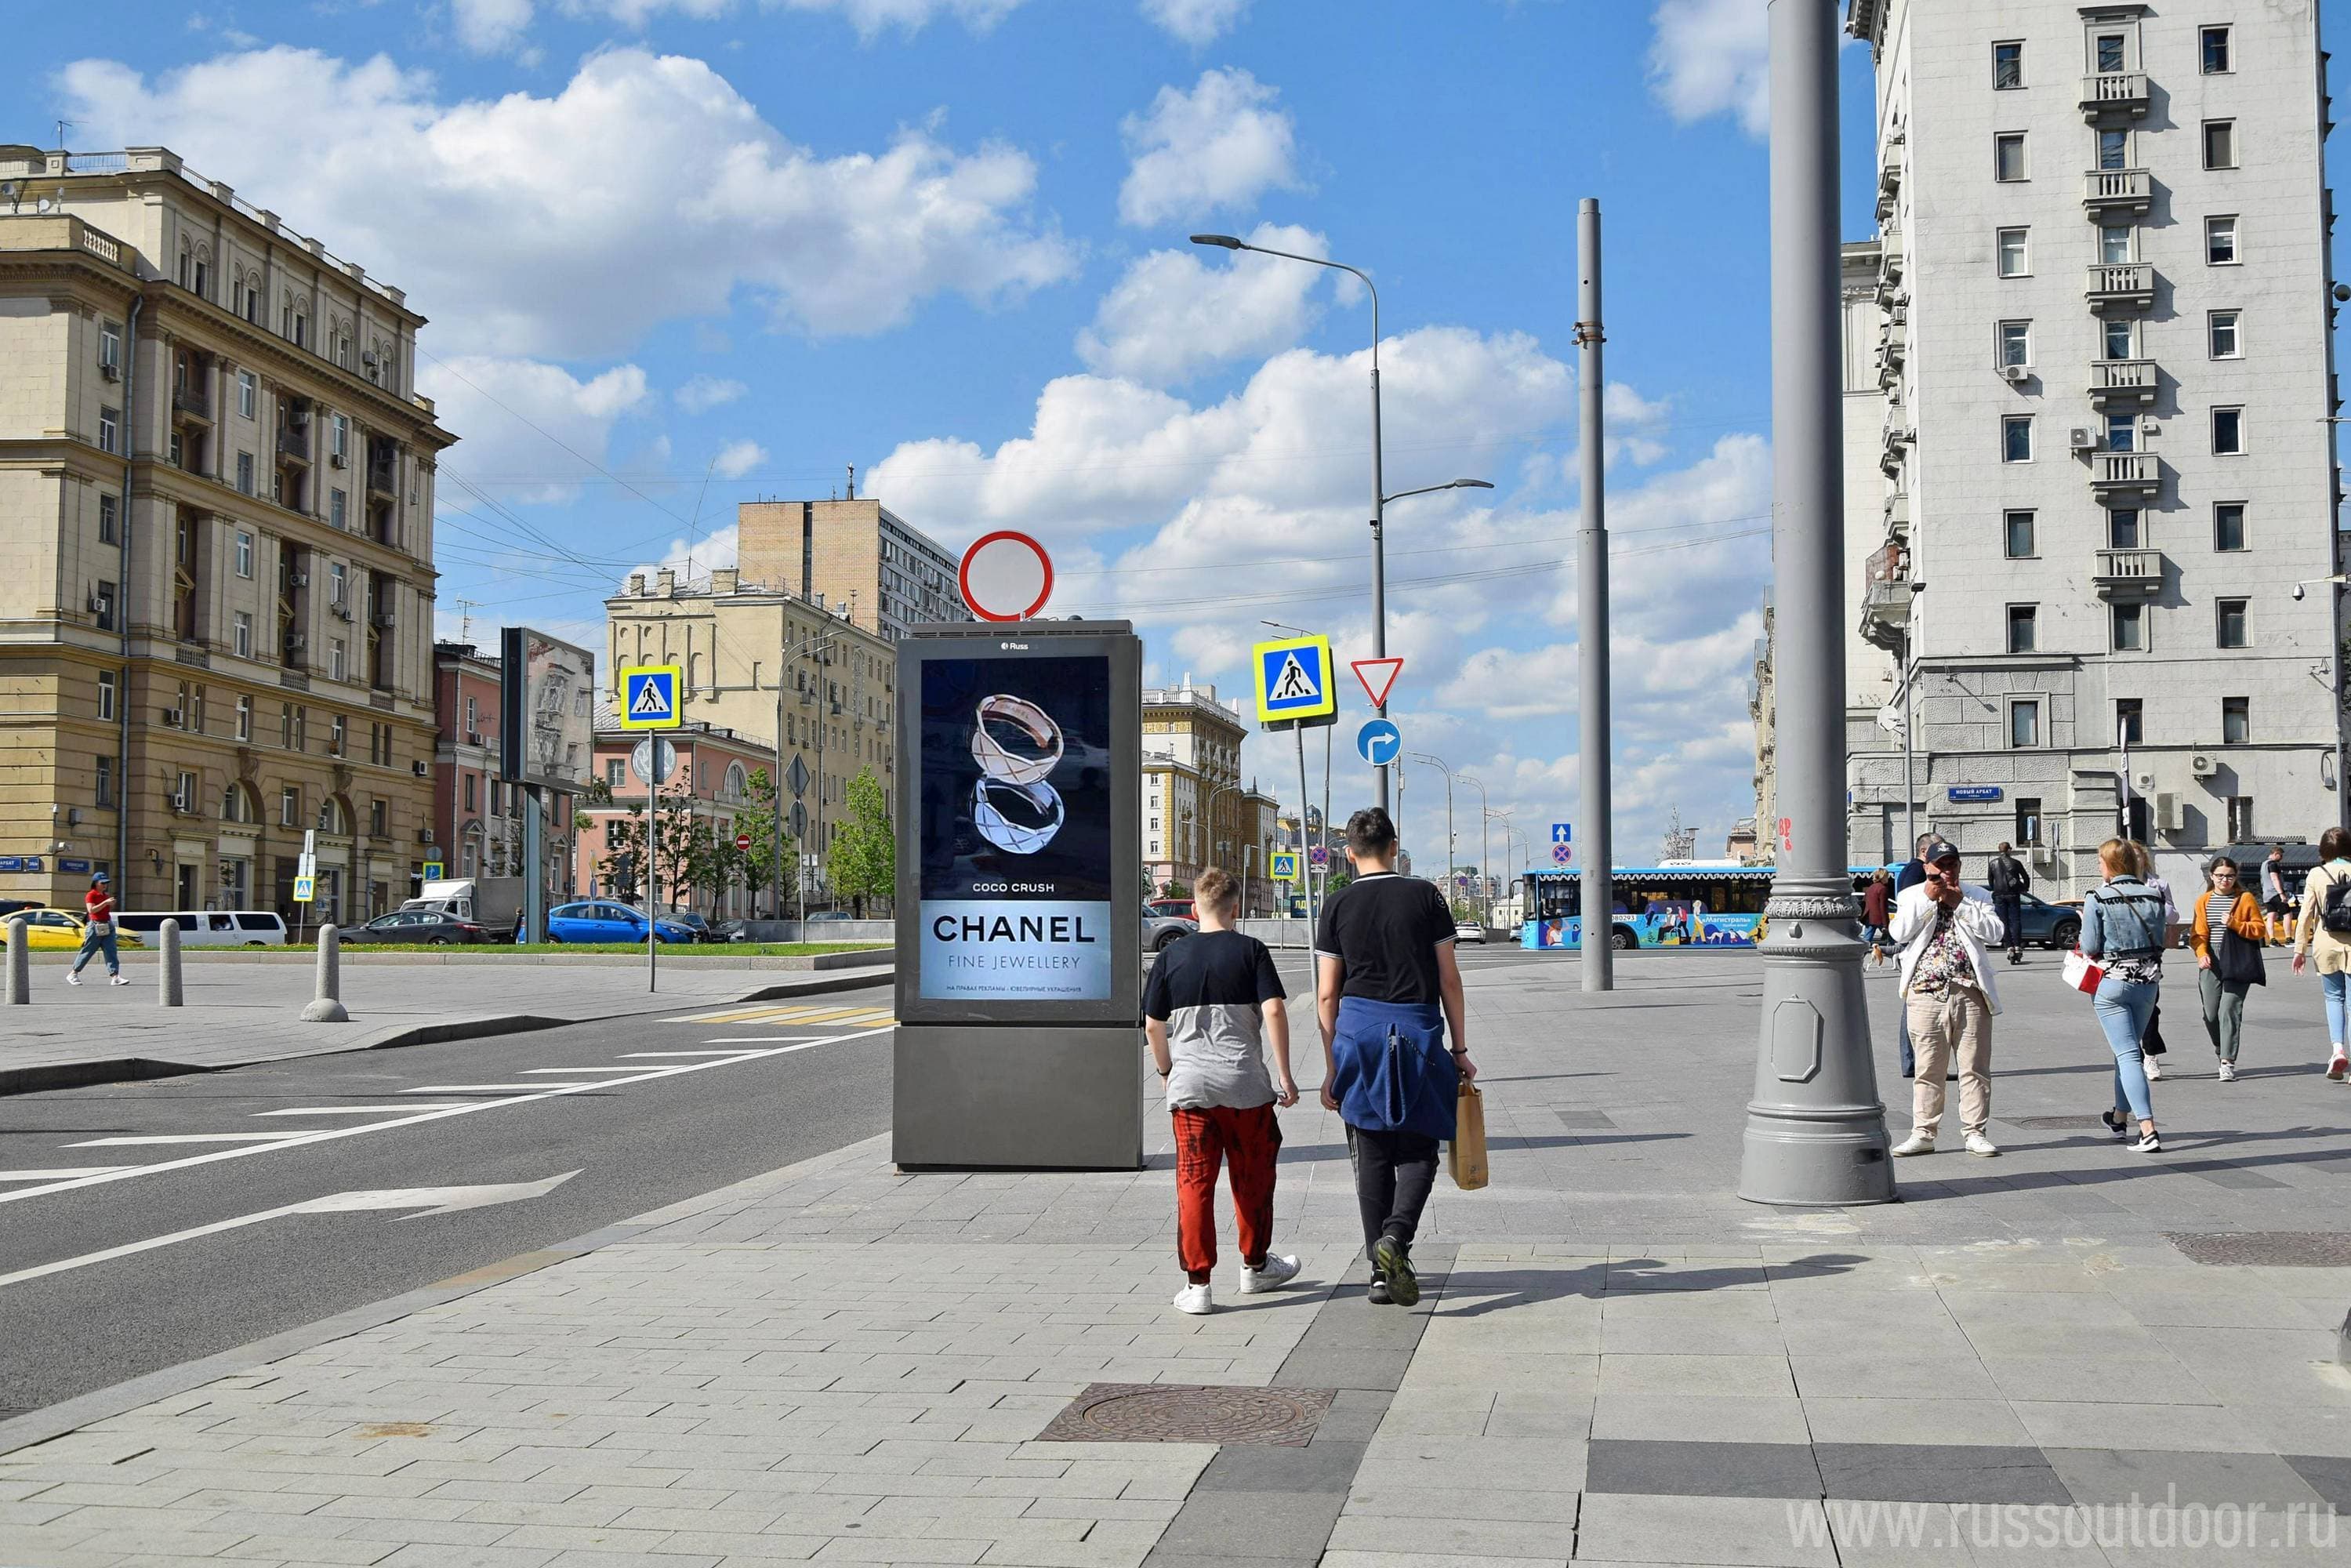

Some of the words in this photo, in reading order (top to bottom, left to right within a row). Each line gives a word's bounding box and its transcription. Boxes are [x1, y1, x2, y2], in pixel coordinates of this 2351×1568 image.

[972, 883, 1007, 892] COCO
[1011, 883, 1054, 892] CRUSH
[1295, 900, 1317, 910] ЛДР
[933, 915, 1095, 942] CHANEL
[949, 955, 985, 968] FINE
[992, 955, 1080, 970] JEWELLERY
